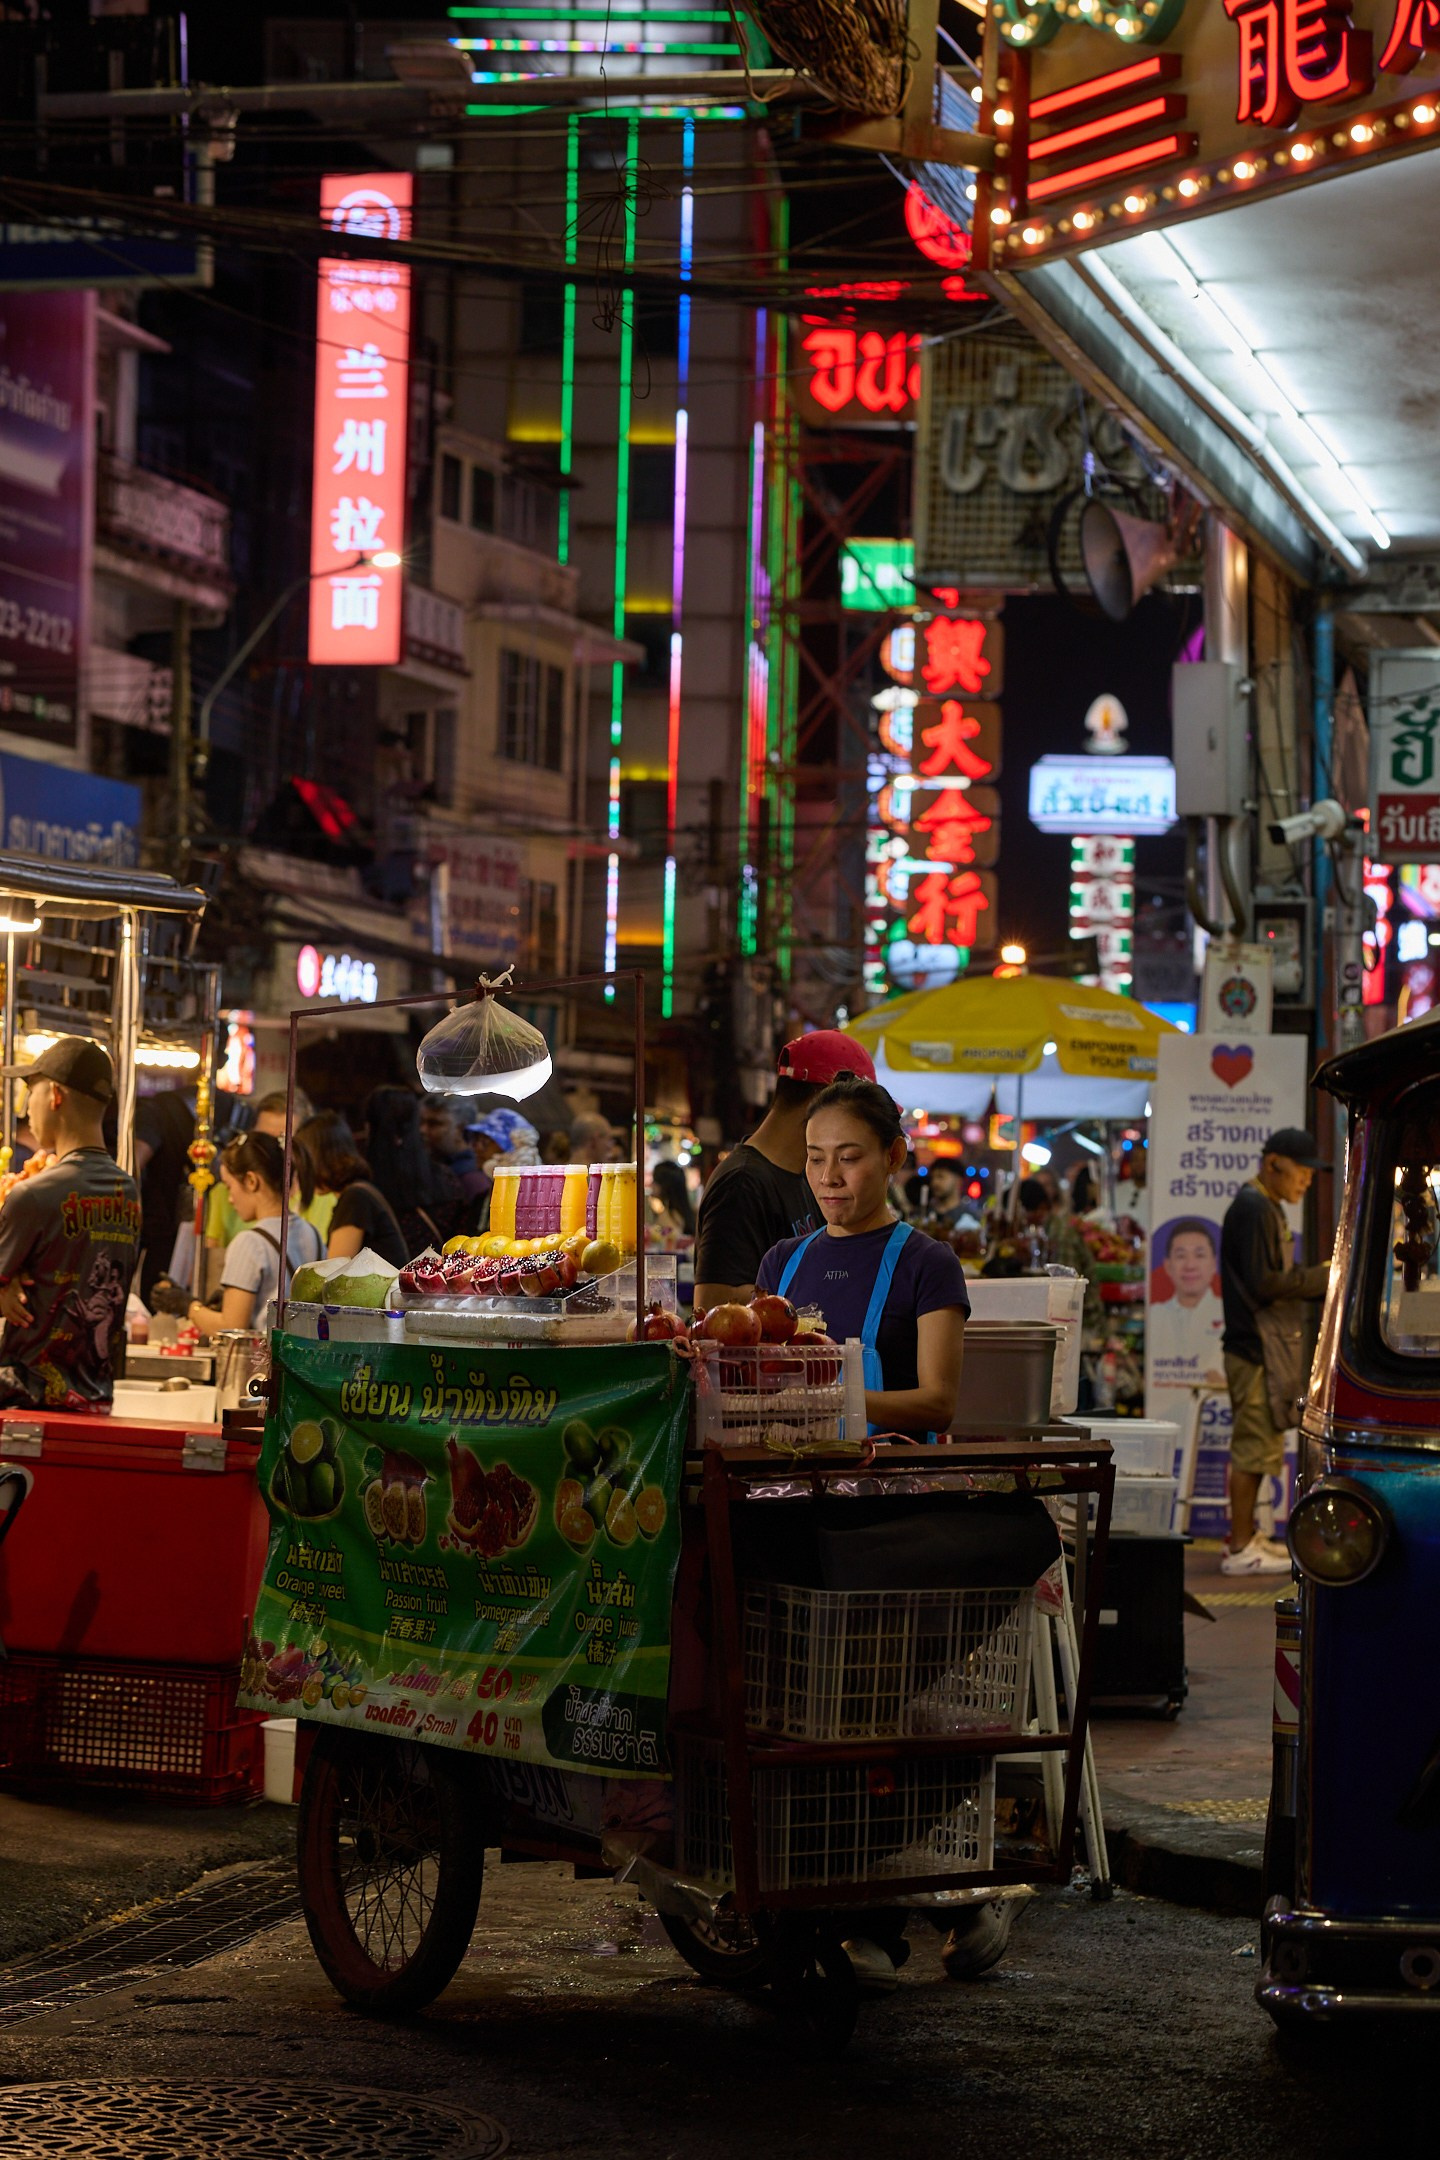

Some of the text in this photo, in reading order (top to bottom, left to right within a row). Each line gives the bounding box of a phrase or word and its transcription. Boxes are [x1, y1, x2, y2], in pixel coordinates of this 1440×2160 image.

[330, 342, 388, 631] 兰州拉面
[1180, 1147, 1264, 1171] สร้างงา
[1170, 1174, 1240, 1198] สร้างอ
[419, 1352, 559, 1424] น้ำทับทิม
[475, 1551, 551, 1600] น้ำทับทิม
[586, 1558, 636, 1608] น้ำส้ม
[385, 1588, 448, 1615] Passion fruit
[388, 1615, 437, 1643] 百香果汁
[477, 1666, 513, 1701] 50
[365, 1700, 417, 1728] ขวดเล็ก
[467, 1709, 499, 1746] 40
[504, 1716, 523, 1733] บาท
[503, 1732, 521, 1750] THB
[571, 1726, 659, 1765] ธรรมชาติ
